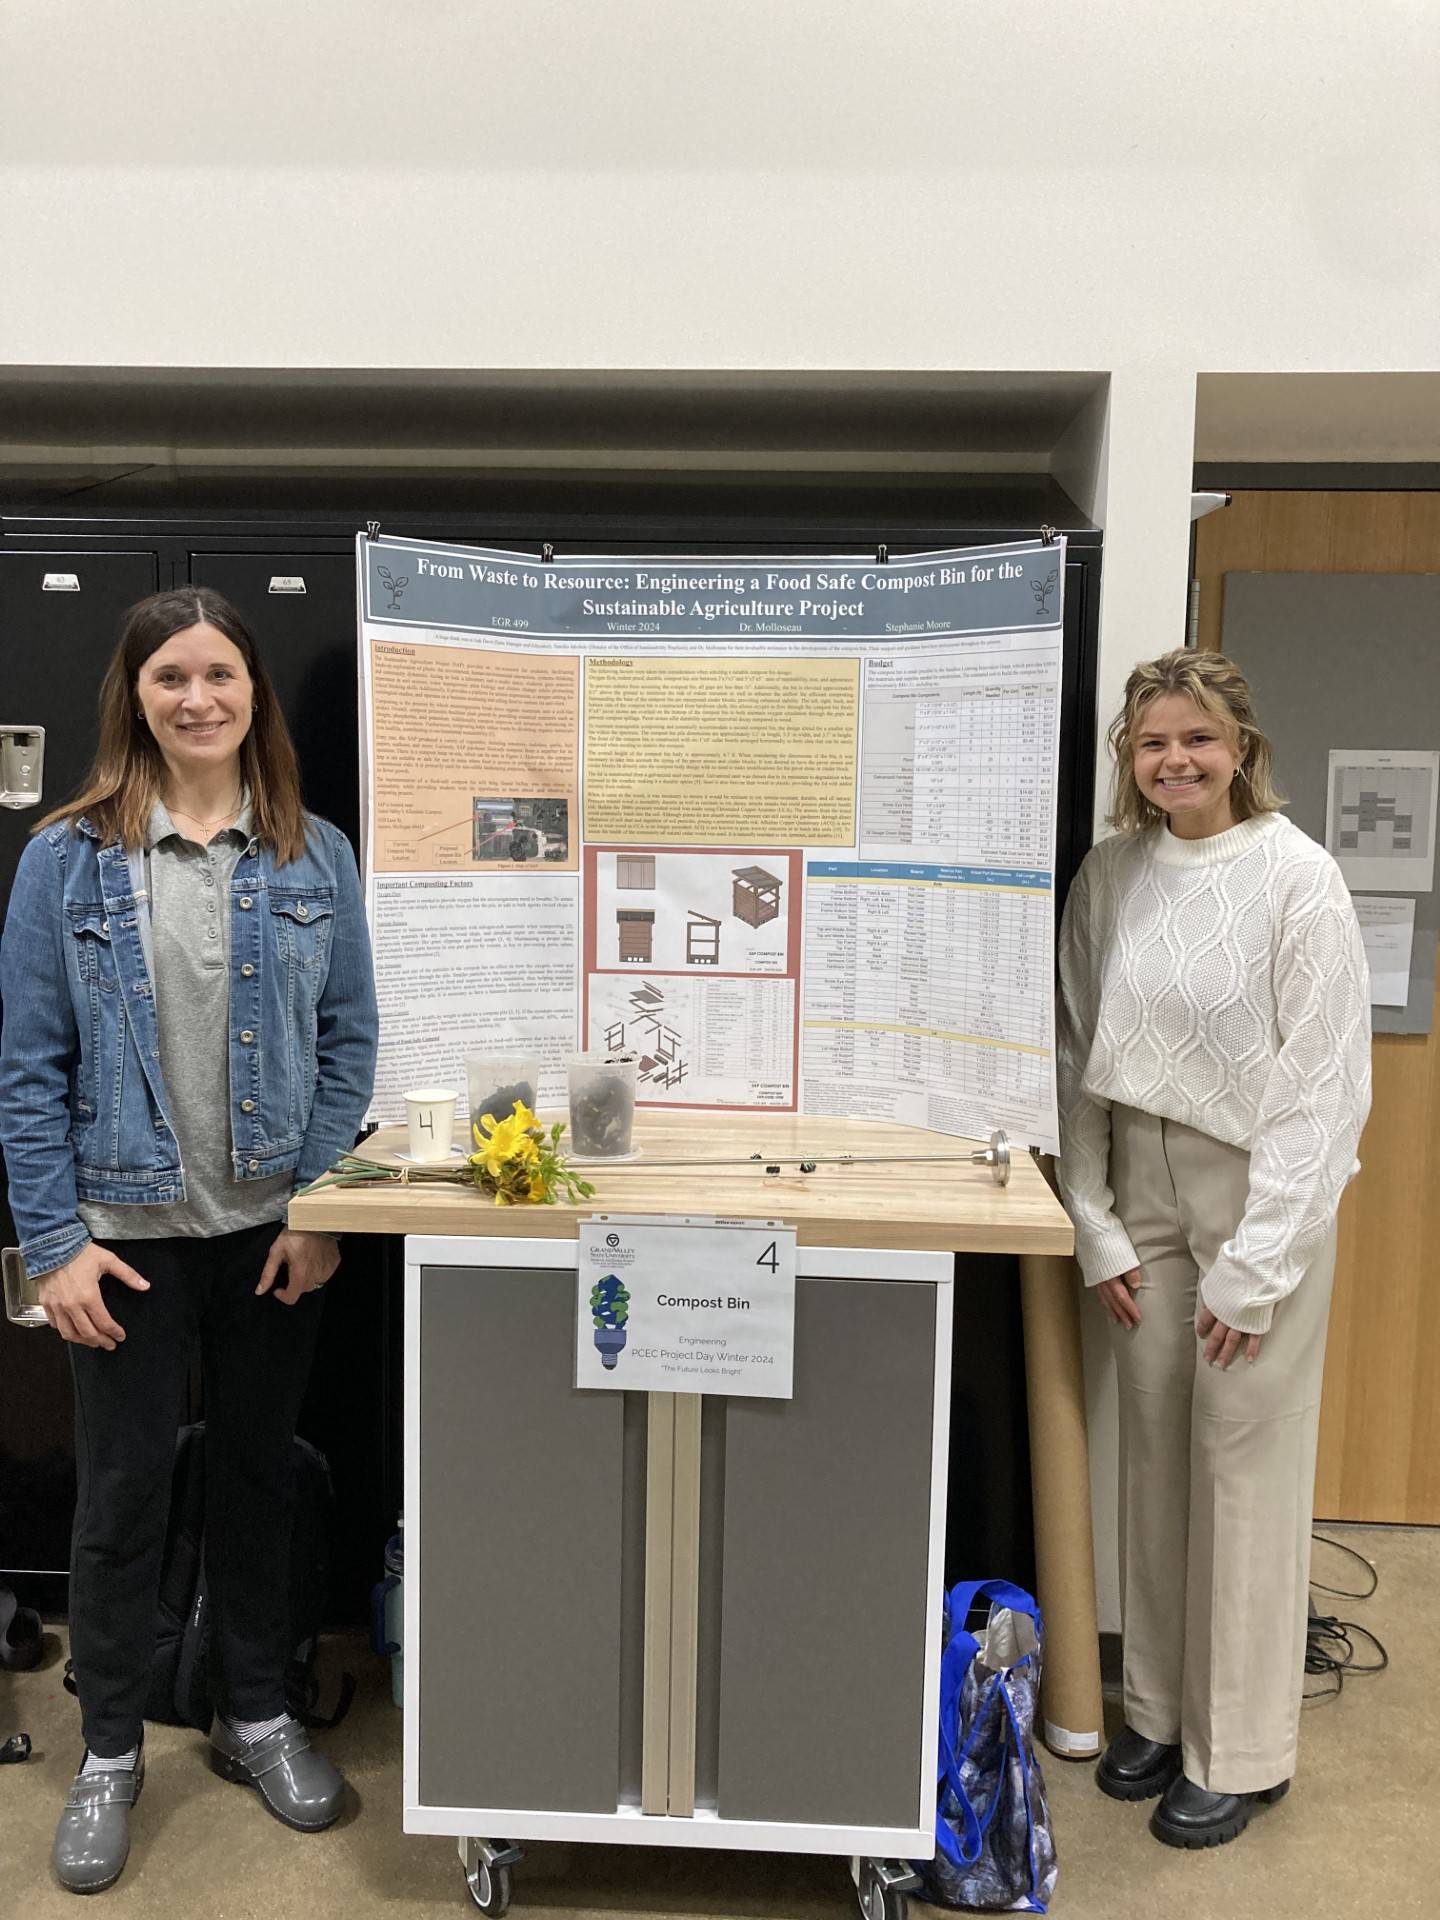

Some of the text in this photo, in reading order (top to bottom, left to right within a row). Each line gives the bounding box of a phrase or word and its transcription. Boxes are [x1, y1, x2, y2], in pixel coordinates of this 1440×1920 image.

[417, 558, 1023, 594] From Waste to Resource: Engineering a Food Safe Compost Bin for the
[583, 599, 864, 621] Sustainable Agriculture Project
[491, 617, 529, 629] EGR 499
[607, 622, 660, 632] Winter 2024
[739, 622, 754, 632] Dr.
[885, 620, 951, 633] Stephanie Moore
[374, 644, 416, 655] Introduction
[589, 658, 633, 667] Methodology
[868, 659, 894, 668] Budget
[377, 880, 473, 889] Important Composting Factors
[419, 1110, 434, 1140] 4
[756, 1241, 780, 1274] 4
[657, 1294, 750, 1310] Compost Bin
[678, 1336, 727, 1346] Engineering
[631, 1349, 774, 1364] PCEC Project Day Winter 2024
